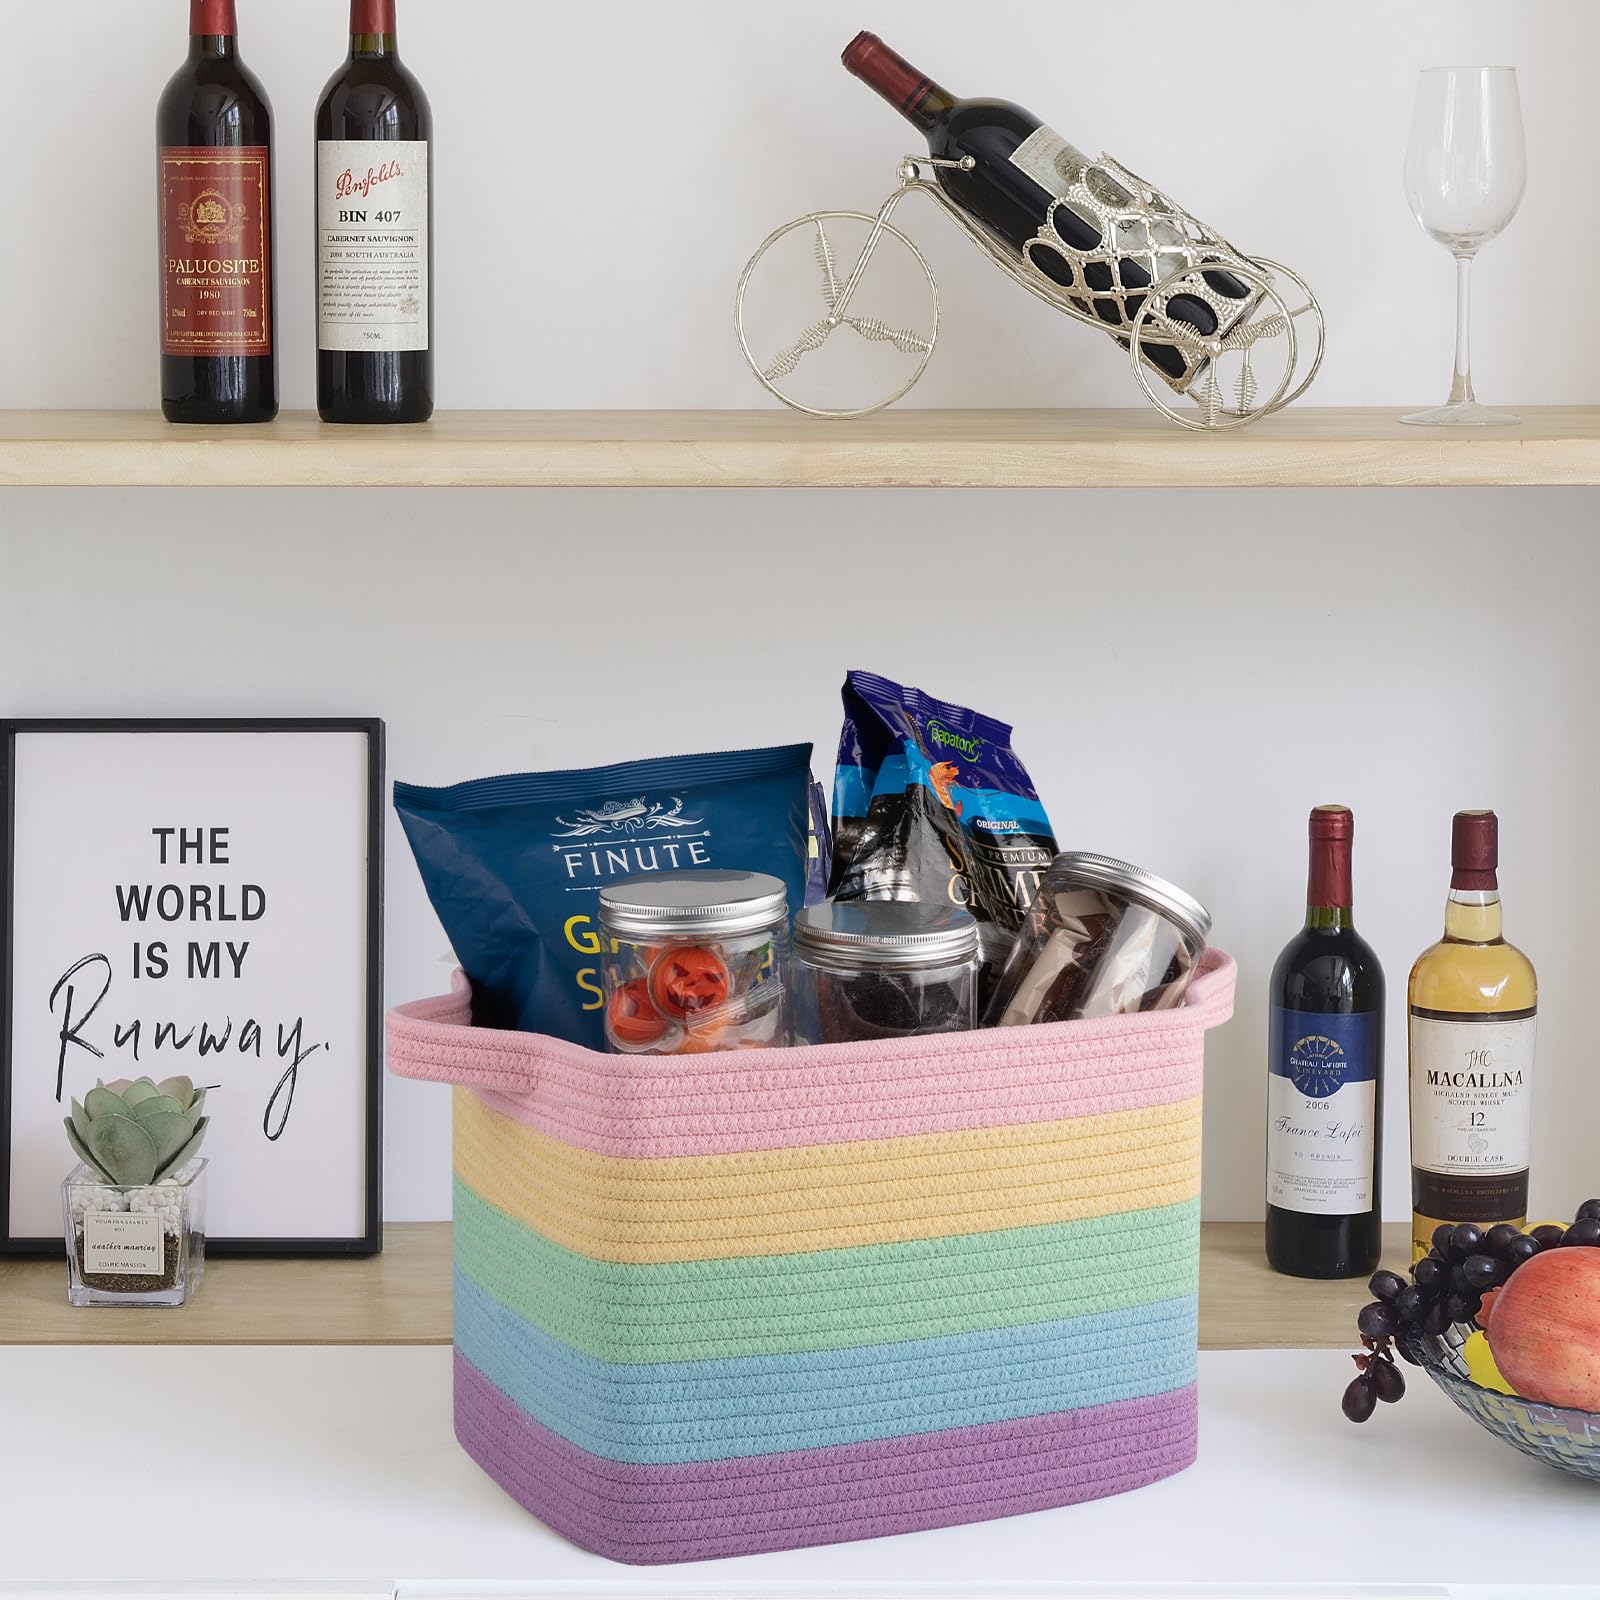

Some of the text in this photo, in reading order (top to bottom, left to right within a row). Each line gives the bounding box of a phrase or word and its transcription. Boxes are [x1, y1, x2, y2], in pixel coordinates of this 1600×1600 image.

[339, 210, 402, 223] BIN 407
[327, 235, 415, 243] CABERNET SAUVIGNON
[345, 251, 373, 259] SOUTH
[373, 251, 415, 259] AUSTRALIA
[168, 258, 260, 274] PALUOSITE
[176, 277, 251, 286] CABERNET SAUVIGNON
[199, 290, 221, 300] 1980
[976, 818, 1020, 830] ORIGINAL
[151, 827, 230, 865] THE
[563, 840, 711, 879] FINUTE
[988, 850, 1049, 863] PREMIUM
[115, 883, 267, 922] WORLD
[132, 941, 250, 979] IS MY
[49, 952, 330, 1142] Runway.
[1296, 1066, 1341, 1076] VINEYARD
[1426, 1069, 1523, 1088] MACALLNA
[1305, 1100, 1330, 1110] 2006
[1448, 1099, 1476, 1107] SCOTCH
[1471, 1111, 1486, 1127] 12
[1274, 1116, 1363, 1144] France Lafei
[1447, 1154, 1504, 1163] DOUBLE CASK
